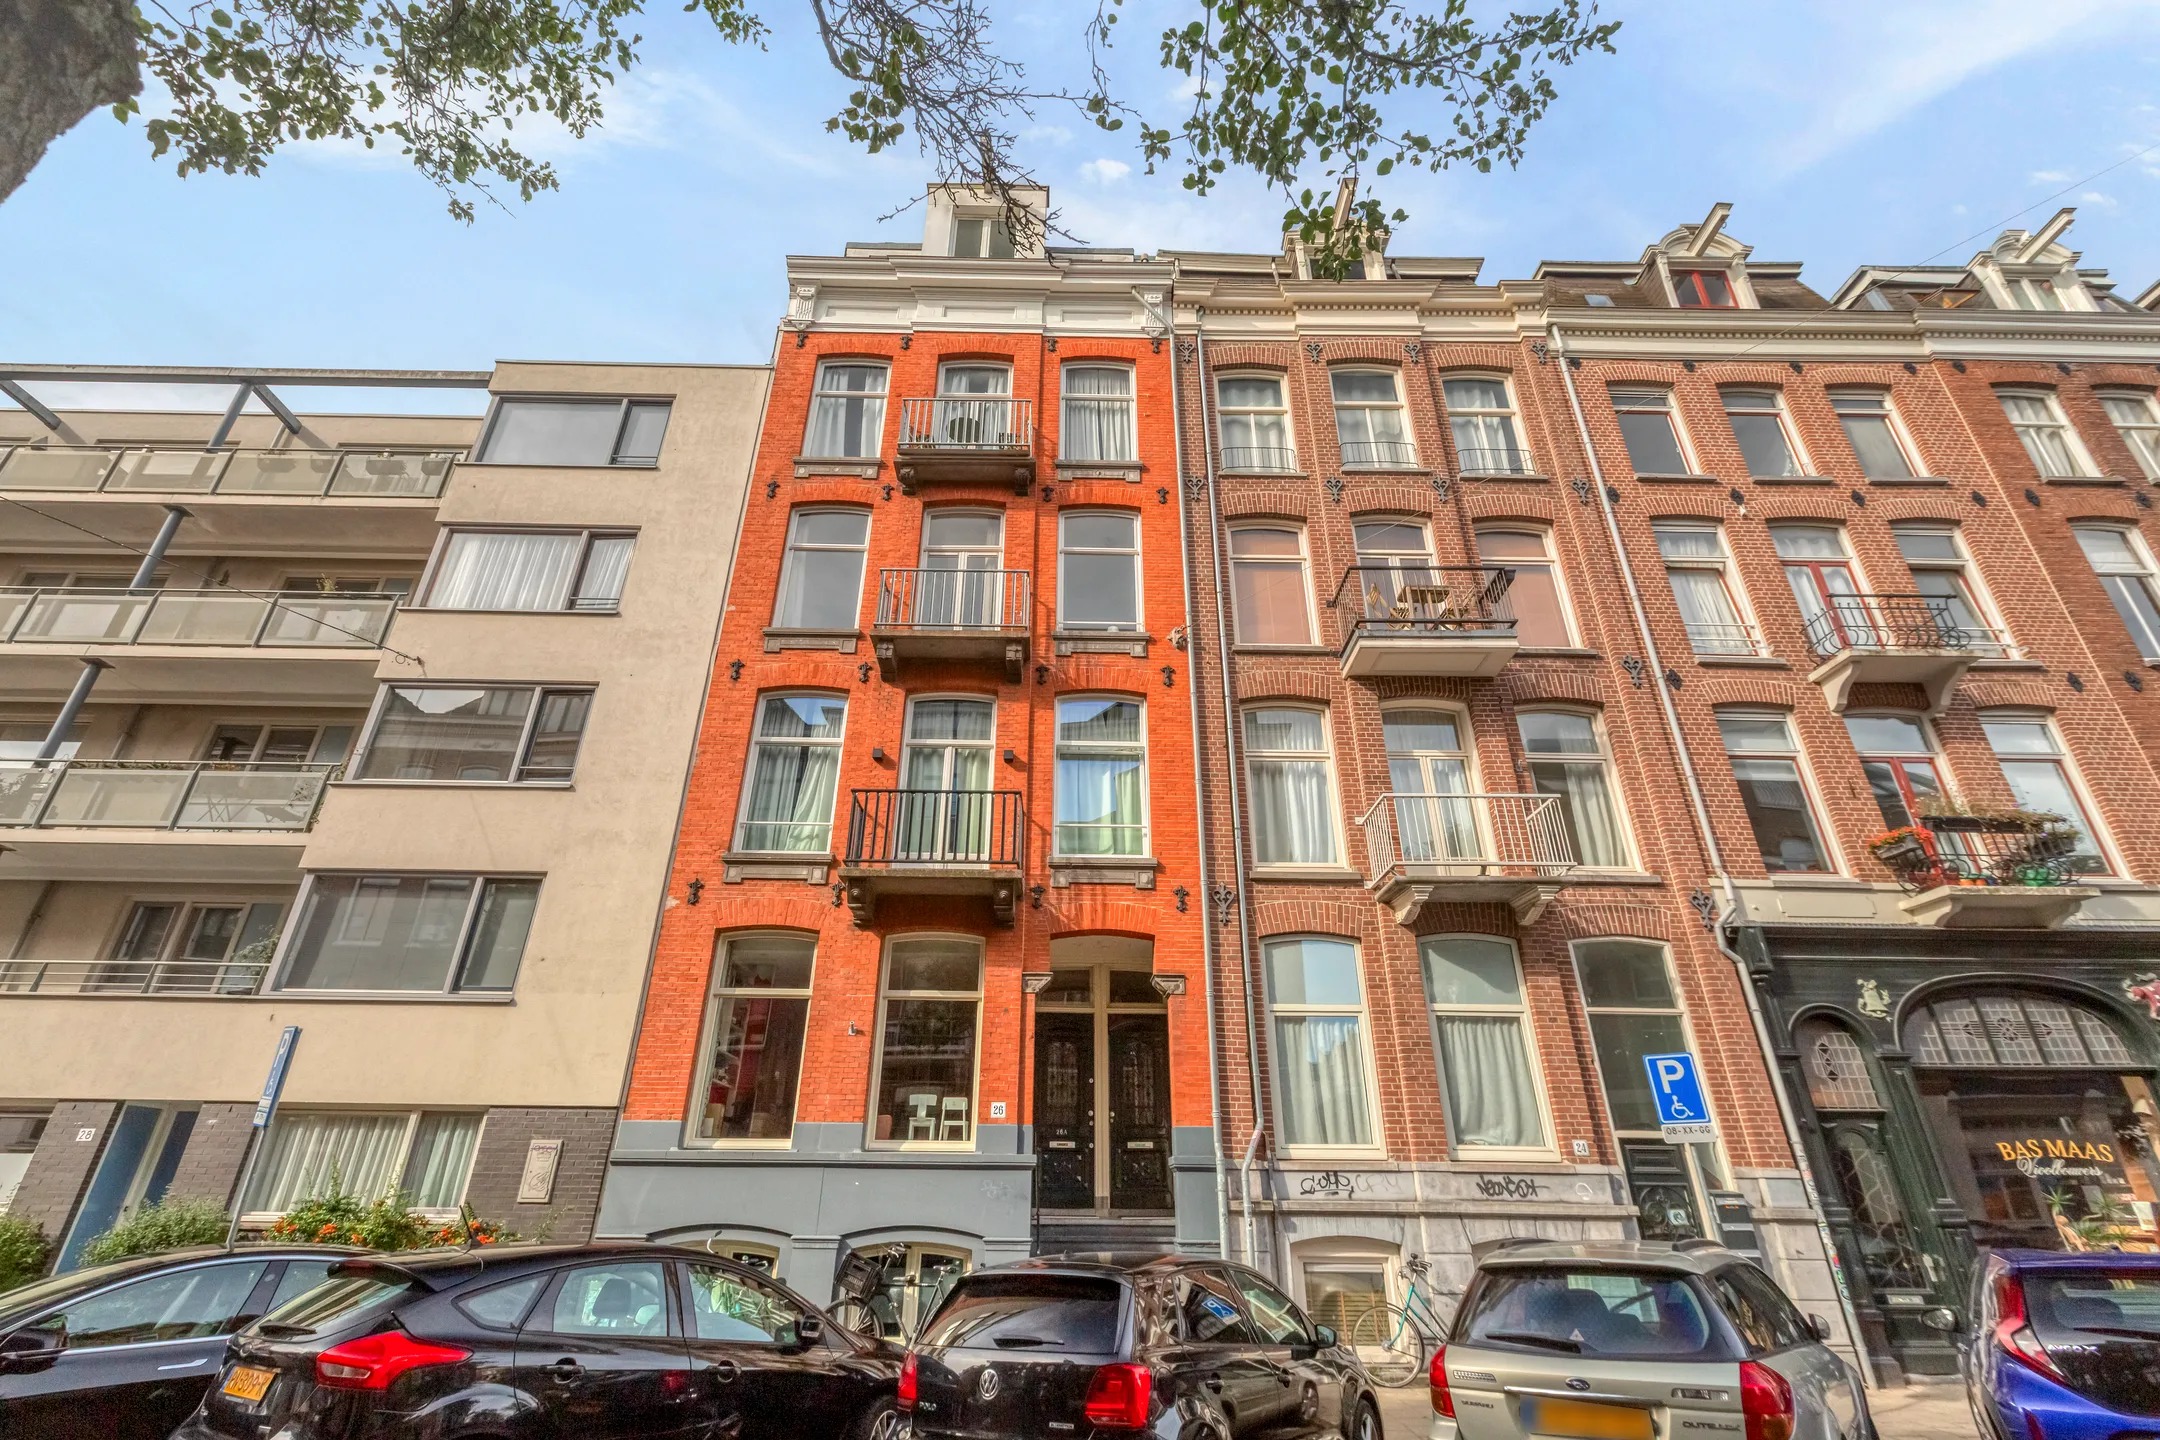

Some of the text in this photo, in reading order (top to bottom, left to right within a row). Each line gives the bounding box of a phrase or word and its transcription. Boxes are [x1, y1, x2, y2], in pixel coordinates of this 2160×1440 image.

[1656, 1059, 1685, 1093] P
[993, 1104, 1004, 1116] 26
[78, 1130, 93, 1140] 28
[1666, 1125, 1711, 1136] 08-XX-GG
[1575, 1142, 1588, 1153] 24
[1995, 1138, 2114, 1163] BAS MAAS
